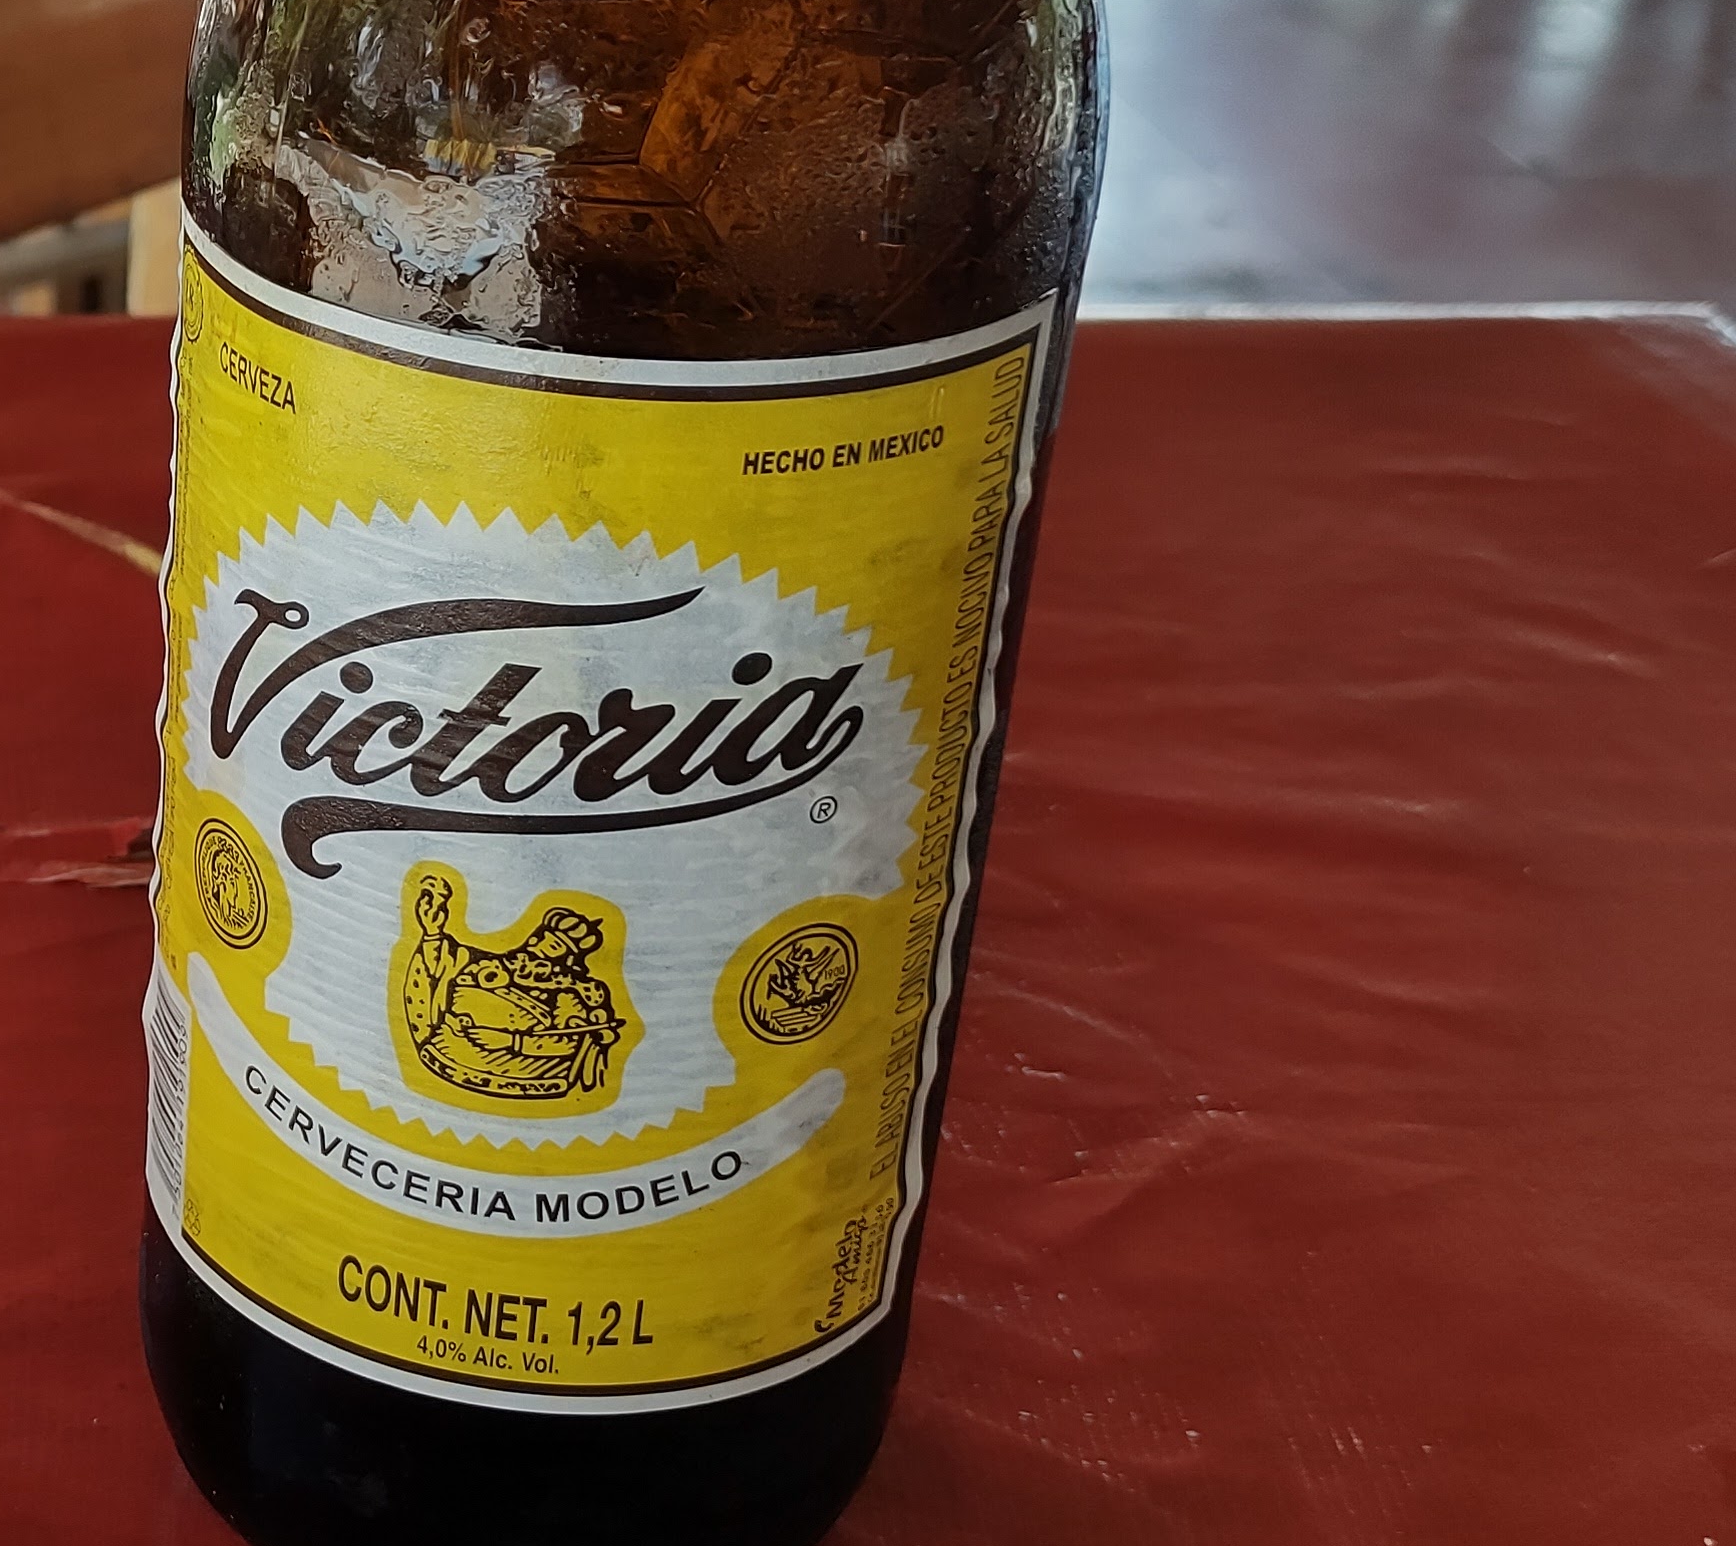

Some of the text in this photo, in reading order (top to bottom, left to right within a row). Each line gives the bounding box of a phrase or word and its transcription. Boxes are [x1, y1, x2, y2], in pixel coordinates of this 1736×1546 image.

[219, 342, 296, 414] CERVEZA
[984, 356, 1025, 445] SALUD
[742, 425, 944, 475] HECHO EN MEXICO
[979, 446, 1008, 486] LA
[969, 481, 1003, 553] PARA
[953, 551, 993, 649] NOCIVO
[947, 649, 977, 682] ES
[210, 587, 864, 878] Victoria
[927, 684, 968, 813] PRODUCTO
[919, 813, 951, 875] ESTE
[914, 866, 943, 903] DE
[824, 965, 845, 980] 1900
[895, 899, 941, 1014] CONSUMO
[891, 1010, 922, 1049] EL
[885, 1047, 913, 1083] EN
[245, 1065, 742, 1222] CERVECERIA MODELO
[875, 1080, 910, 1150] ABUSO
[870, 1147, 898, 1181] EL
[826, 1217, 857, 1319] Modelo
[338, 1254, 654, 1355] CONT. NET. 1,2 L
[416, 1335, 560, 1374] 4,0% Alc. Vol.
